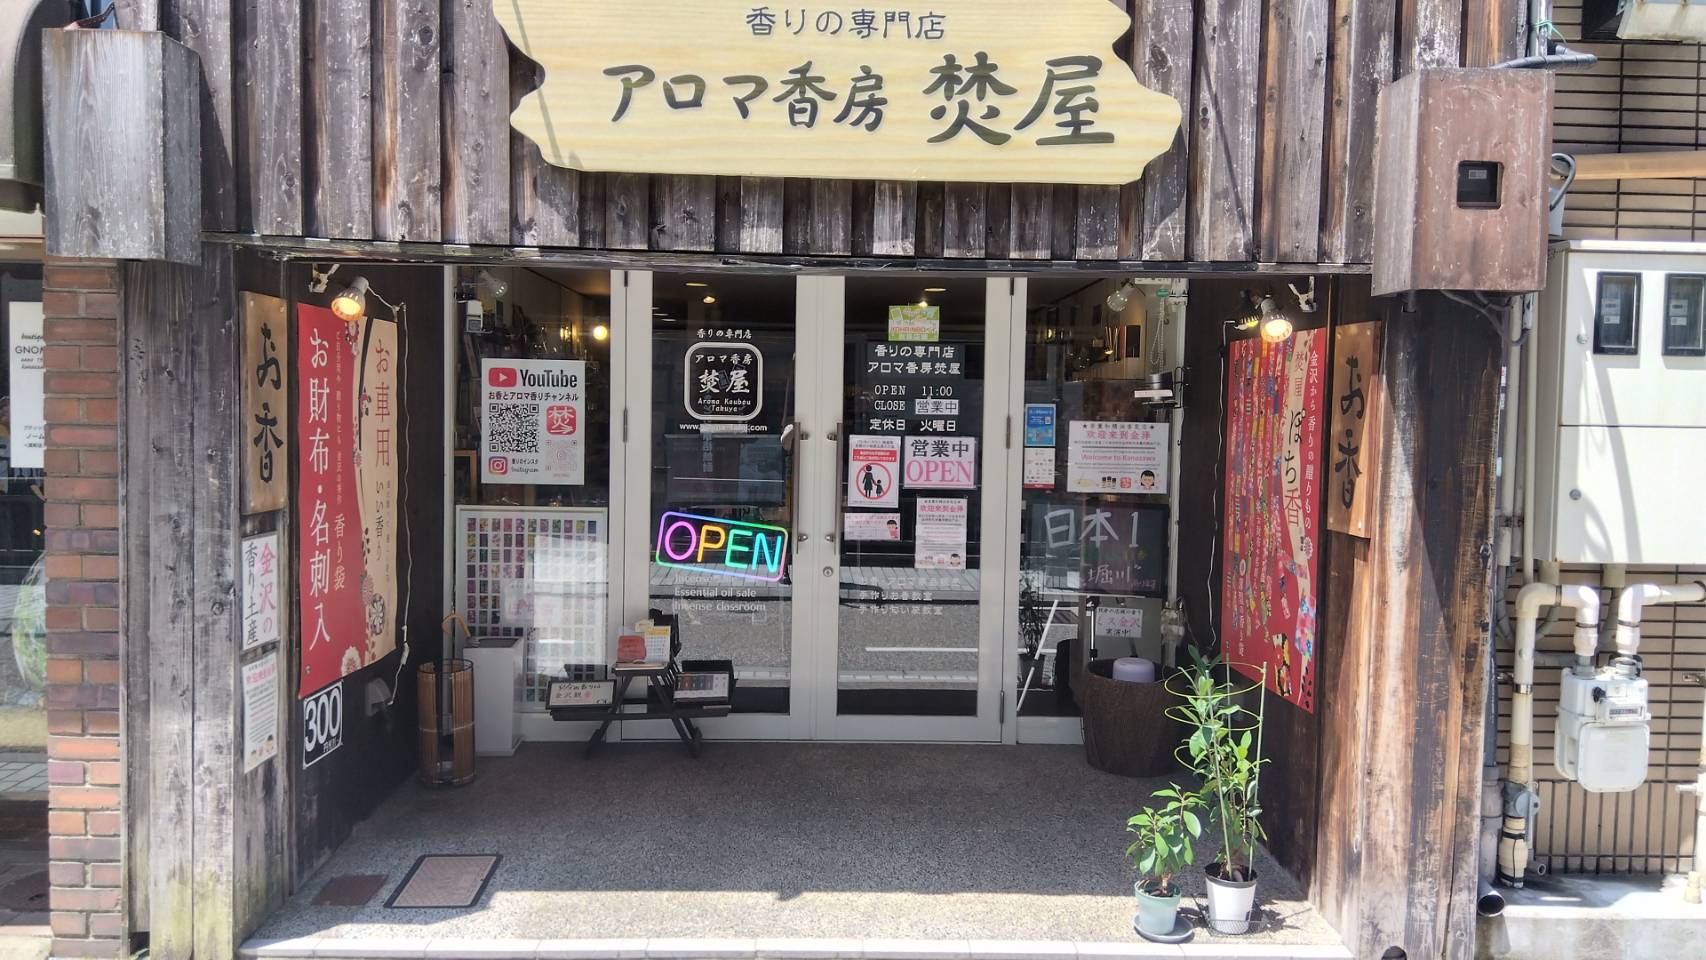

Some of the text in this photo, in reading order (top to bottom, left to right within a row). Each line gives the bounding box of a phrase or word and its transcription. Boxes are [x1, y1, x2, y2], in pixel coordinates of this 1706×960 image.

[743, 7, 947, 40] 香りの専門店
[921, 51, 1115, 148] 焚屋
[696, 328, 752, 339] 香りの専門店
[695, 353, 753, 365] アロマ香房
[874, 344, 955, 358] 香りの専門店
[867, 361, 961, 375] アロマ香房焚屋
[519, 369, 578, 388] YouTube
[698, 369, 750, 394] 焚屋
[488, 391, 579, 402] お香とアロマ香りチャンネル
[874, 385, 953, 396] OPEN 11:00
[874, 400, 957, 413] CLOSE 営業中
[869, 419, 956, 431] 定休日 火曜日
[911, 439, 970, 458] 営業中
[905, 460, 973, 483] OPEN
[664, 520, 782, 573] OPEN
[244, 541, 259, 646] 香り土産
[259, 542, 276, 634] 金沢の
[674, 587, 757, 597] Essential oil sale
[716, 601, 766, 611] classroom
[305, 687, 341, 752] 300
